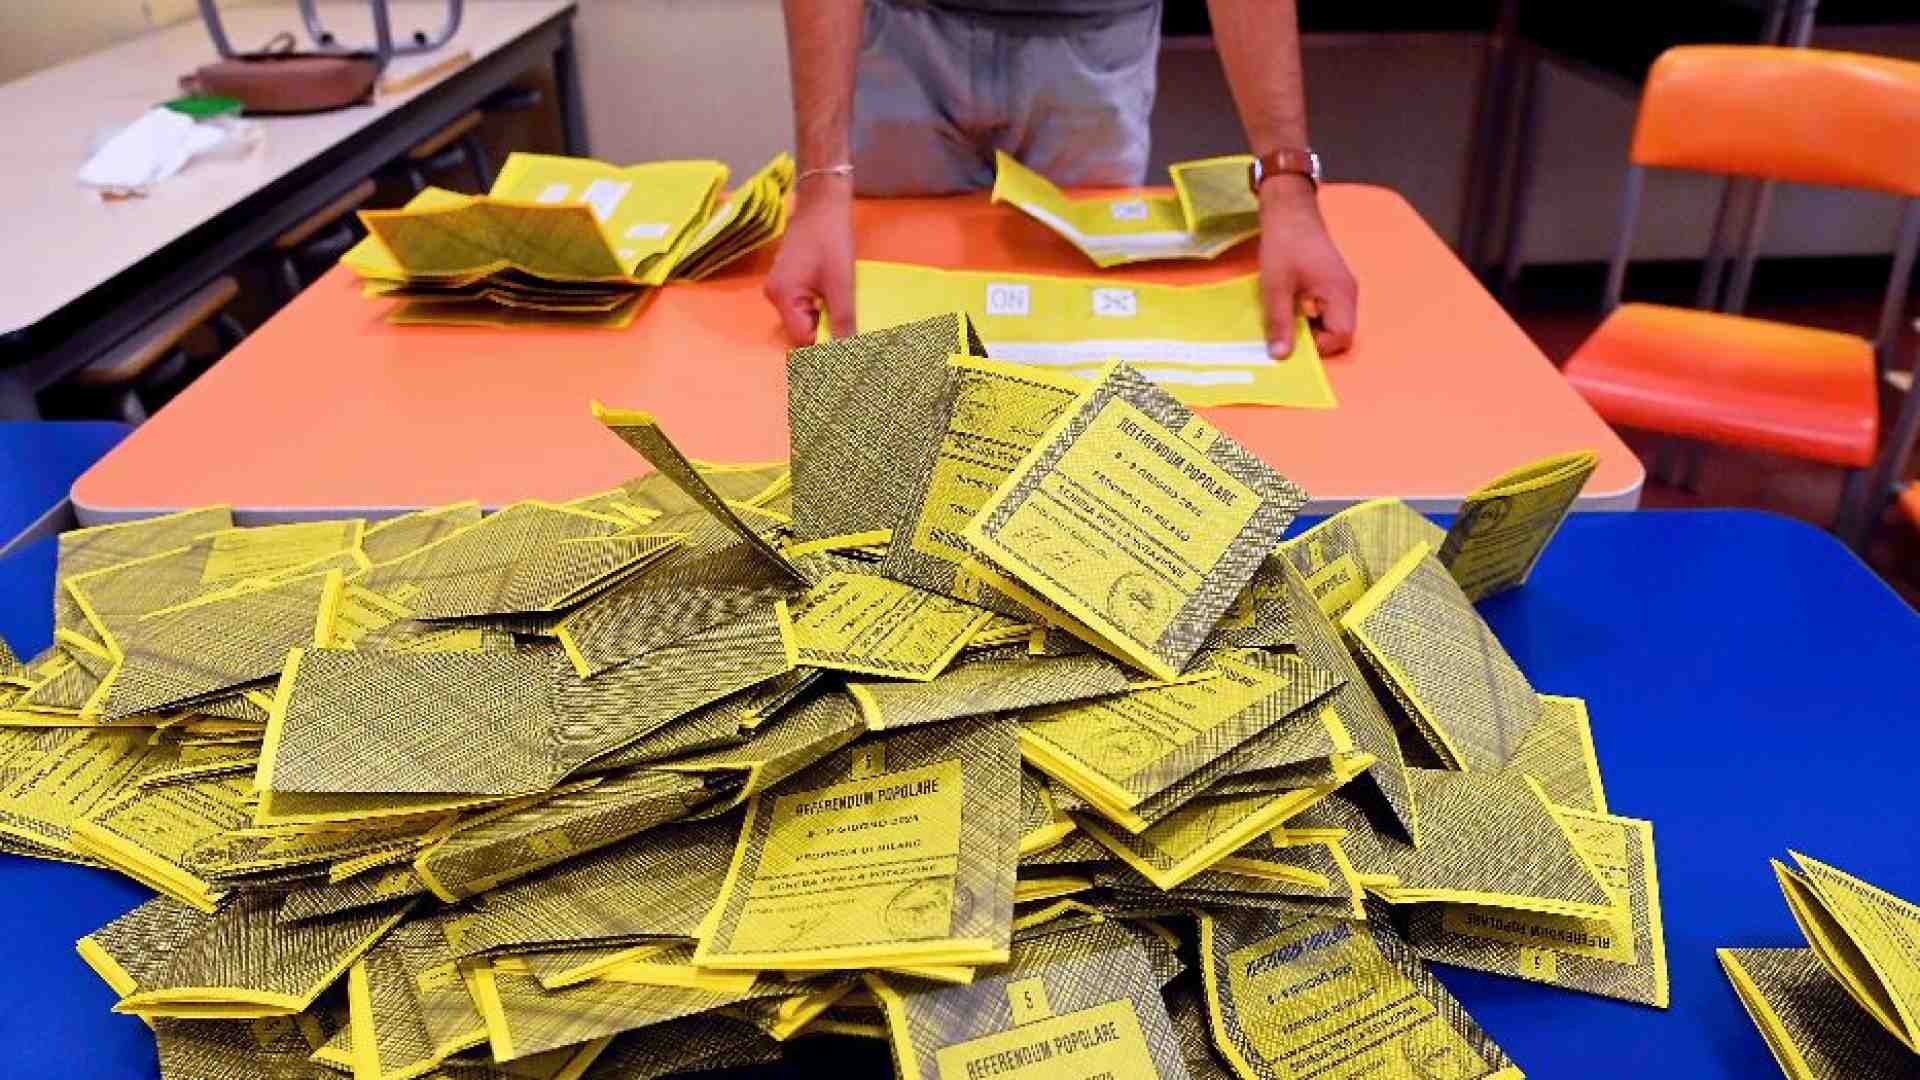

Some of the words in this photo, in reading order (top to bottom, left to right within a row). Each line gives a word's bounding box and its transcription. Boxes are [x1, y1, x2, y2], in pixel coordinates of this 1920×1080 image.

[991, 288, 1024, 310] NO
[1116, 416, 1186, 471] REFERENDUM
[1180, 461, 1239, 508] POPOLARE
[1090, 469, 1142, 509] PROVINCIA
[1152, 512, 1191, 543] MILANO
[795, 791, 875, 817] REFERENDUM
[877, 777, 940, 801] POPOLARE
[1465, 914, 1526, 937] POPOLARE
[1527, 926, 1610, 949] REFERENDUM
[1022, 990, 1035, 1010] 5
[965, 1040, 1054, 1080] REFERENDUM
[1053, 1021, 1120, 1056] POPOLARE
